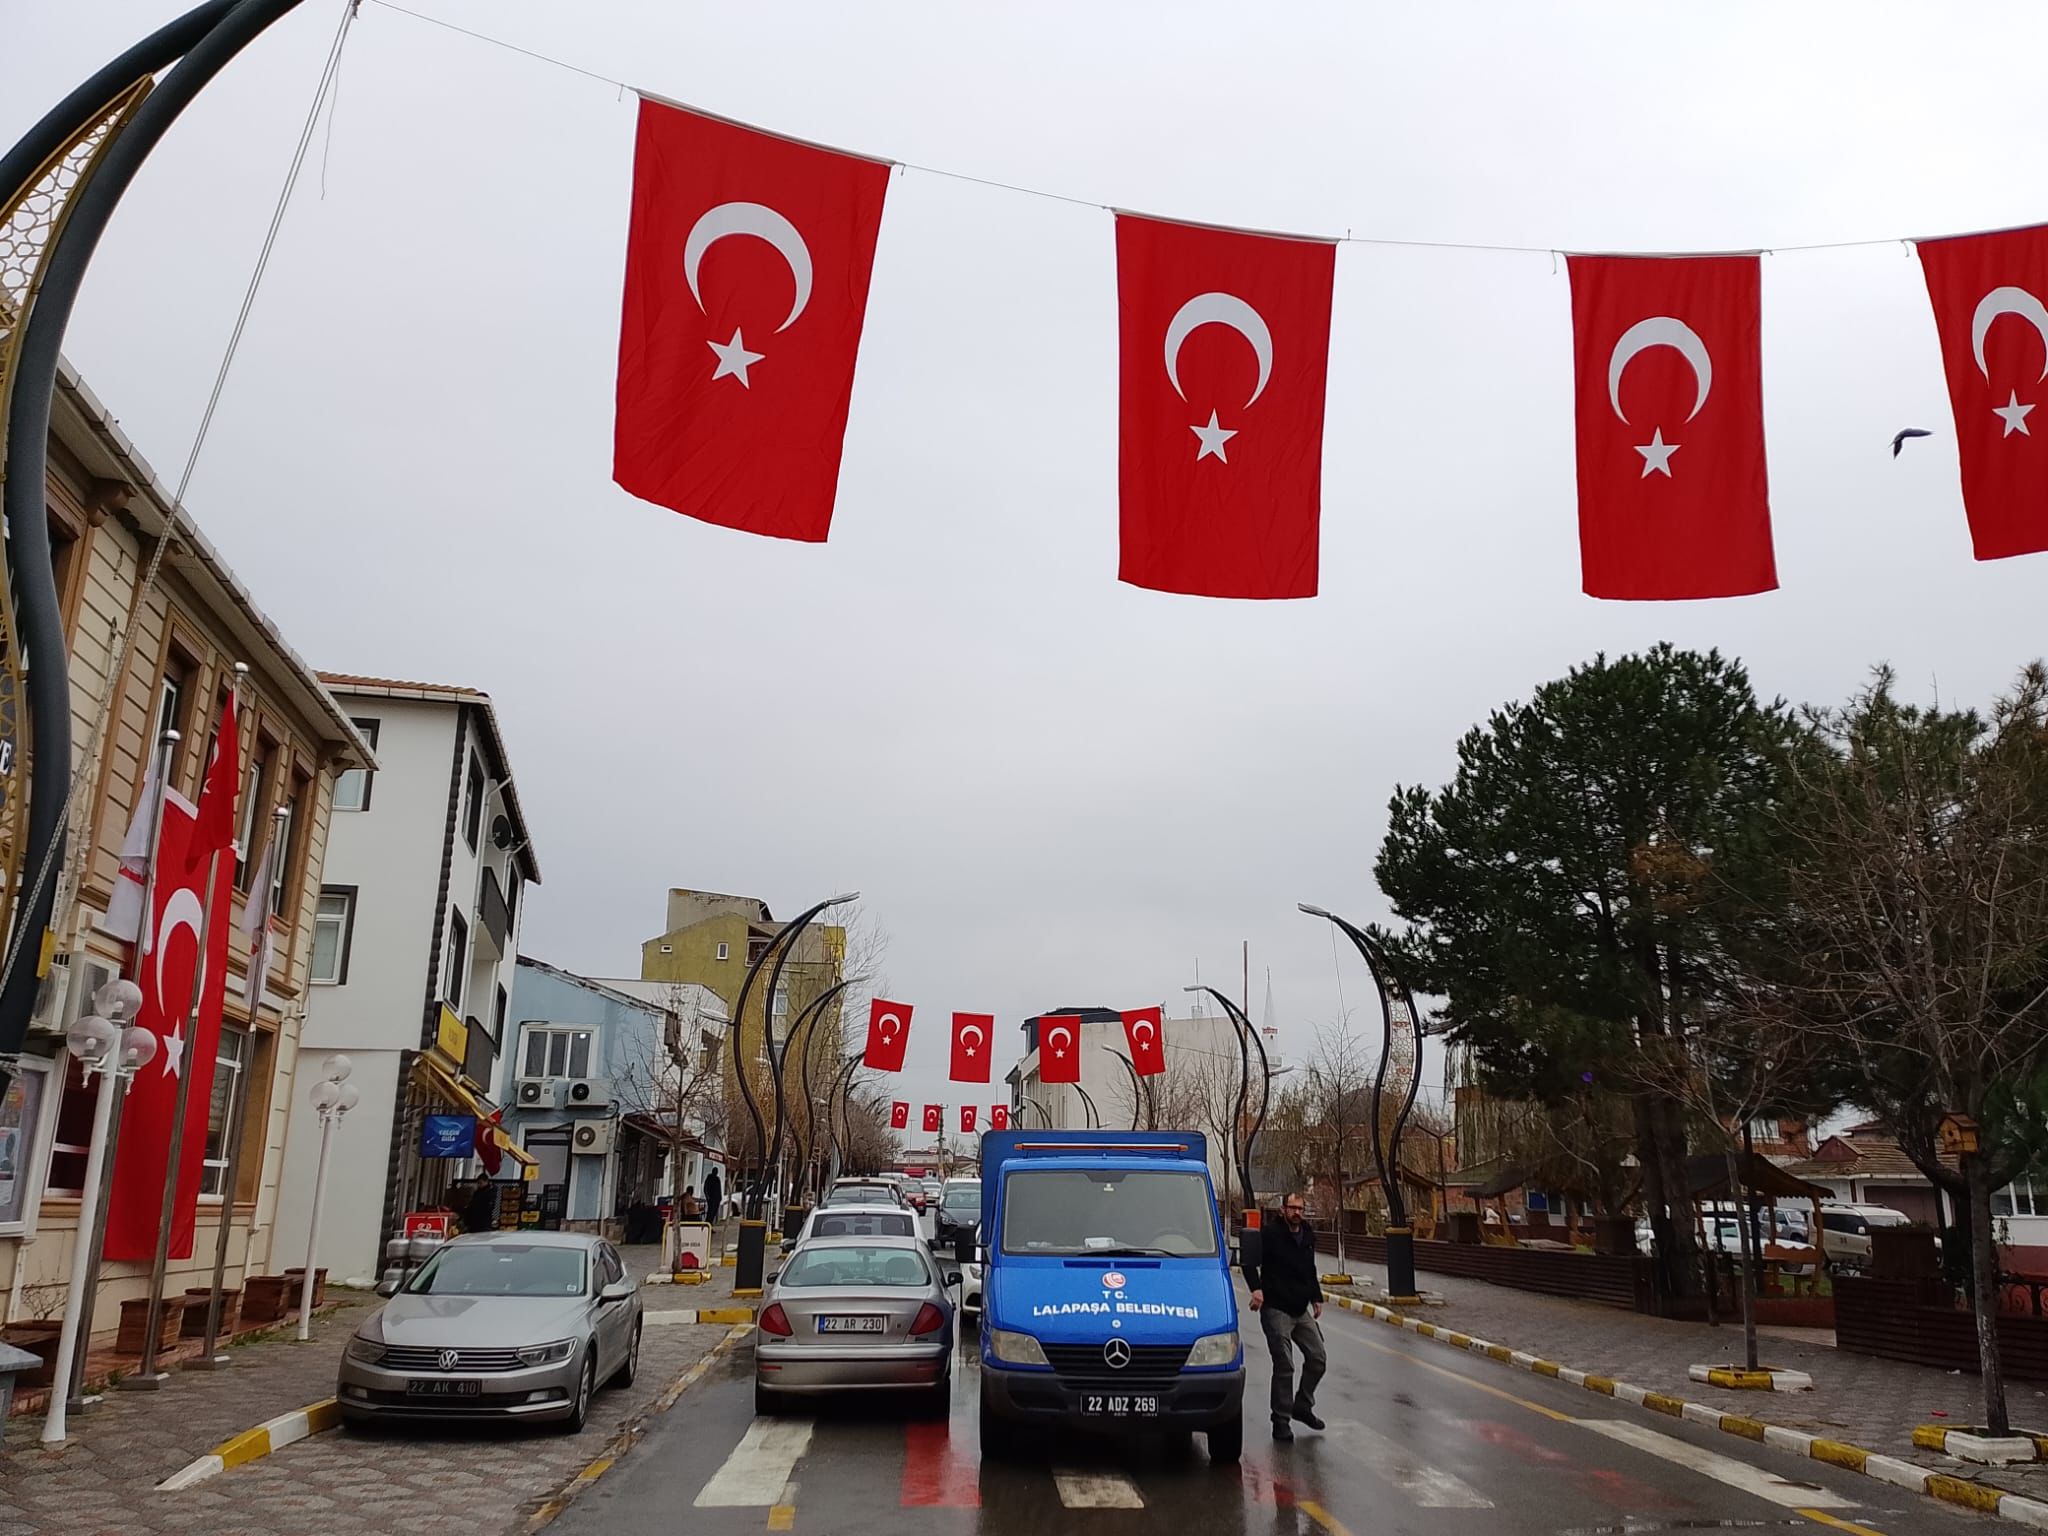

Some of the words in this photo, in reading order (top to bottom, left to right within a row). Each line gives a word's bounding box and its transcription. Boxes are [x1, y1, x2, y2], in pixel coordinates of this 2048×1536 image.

[1033, 1302, 1111, 1316] LALAPAŞA
[1116, 1302, 1199, 1319] BELEDİYESİ
[825, 1318, 836, 1330] 22
[843, 1317, 856, 1330] AR
[862, 1318, 881, 1330] 230
[410, 1381, 425, 1393] 22
[433, 1381, 449, 1393] AK
[1088, 1396, 1103, 1412] 22
[1107, 1396, 1129, 1412] ADZ
[1134, 1397, 1156, 1412] 269
